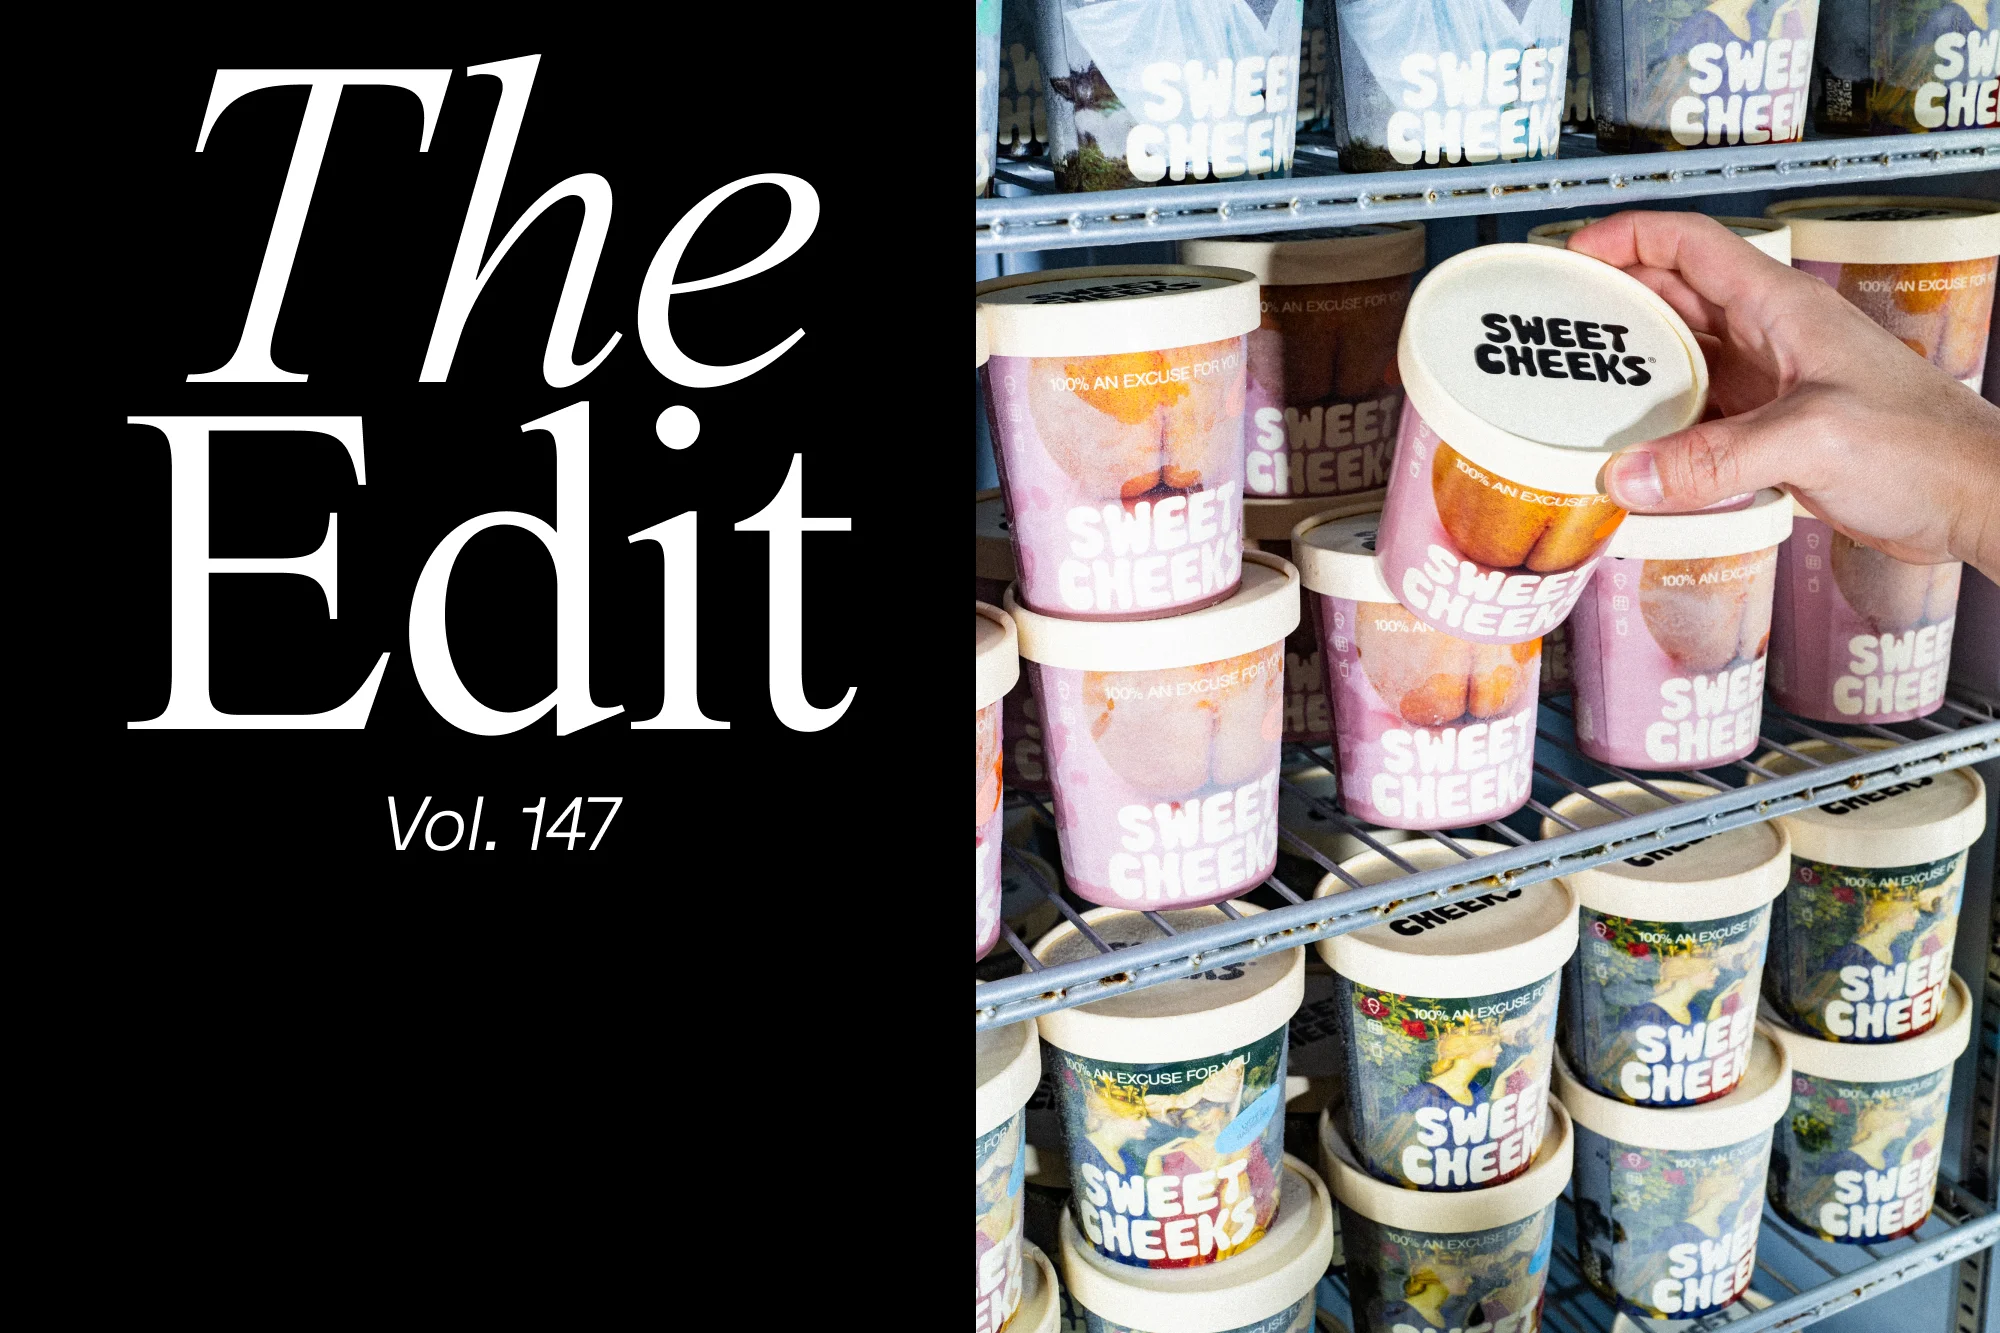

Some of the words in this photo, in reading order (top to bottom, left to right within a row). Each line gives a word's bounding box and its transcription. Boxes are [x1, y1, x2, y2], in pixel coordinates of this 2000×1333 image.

[1400, 46, 1564, 109] SWEET
[1914, 79, 2000, 128] CHE
[1282, 301, 1302, 313] AN
[1306, 298, 1362, 313] EXCUSE
[1364, 295, 1385, 308] FOR
[1857, 279, 1891, 293] 100%
[1894, 280, 1915, 292] AN
[1918, 277, 1968, 292] EXCUSE
[1481, 313, 1629, 353] SWEET
[1049, 375, 1090, 392] 100%
[1093, 375, 1119, 391] AN
[1123, 366, 1191, 389] EXCUSE
[1193, 359, 1219, 379] FOR
[1220, 353, 1239, 373] YOU
[1254, 395, 1396, 450] SWEET
[1454, 458, 1490, 487] 100%
[1491, 481, 1518, 499] AN
[1519, 491, 1591, 508] EXCUSE
[1066, 481, 1236, 559] SWEET
[1059, 531, 1238, 611] CHEEKS
[1423, 544, 1600, 606] SWEET
[1661, 575, 1696, 587] 100%
[1699, 572, 1719, 585] AN
[1374, 619, 1410, 632] 100%
[1104, 685, 1143, 700] 100%
[1147, 682, 1173, 699] AN
[1176, 672, 1238, 697] EXCUSE
[1241, 662, 1265, 683] FOR
[1381, 707, 1532, 774] SWEET
[1117, 767, 1279, 852] SWEET
[1878, 877, 1899, 887] AN
[1901, 868, 1945, 886] EXCUSE
[1638, 931, 1673, 944] 100%
[1675, 931, 1696, 944] AN
[1699, 921, 1748, 943] EXCUSE
[1413, 1008, 1448, 1021] 100%
[1452, 1008, 1475, 1021] AN
[1478, 995, 1530, 1018] EXCUSE
[1065, 1057, 1091, 1077] 100%
[1093, 1067, 1113, 1082] AN
[1117, 1070, 1183, 1086] EXCUSE
[1186, 1064, 1219, 1082] FOR
[1221, 1051, 1251, 1071] YOU
[984, 1129, 1007, 1157] FOR
[1081, 1158, 1248, 1218] SWEET
[1081, 1195, 1257, 1260] CHEEKS
[1387, 1231, 1419, 1248] 100%
[1423, 1238, 1445, 1249] AN
[1448, 1231, 1505, 1250] EXCUSE
